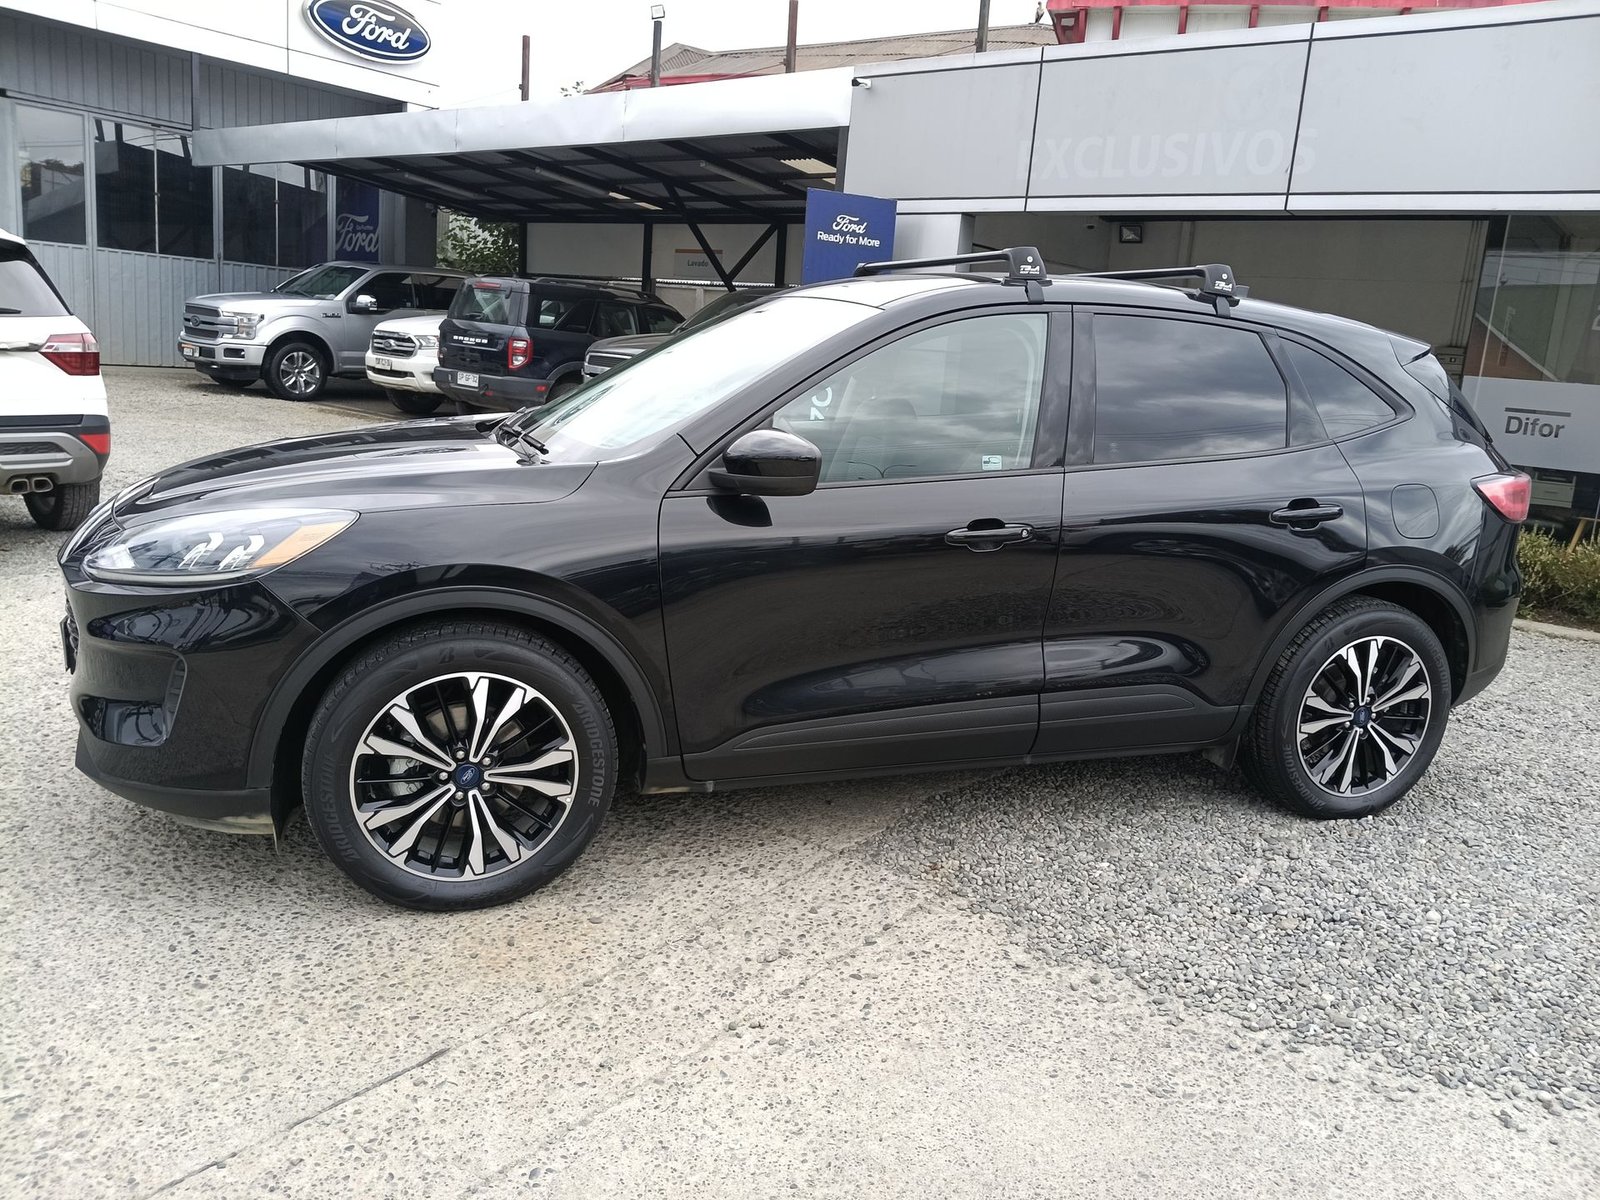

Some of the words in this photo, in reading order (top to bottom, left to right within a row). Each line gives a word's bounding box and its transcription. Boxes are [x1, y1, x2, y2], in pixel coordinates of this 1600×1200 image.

[342, 4, 411, 50] Ford
[1016, 127, 1319, 180] EXCLUSIVOS
[336, 213, 379, 253] Ford
[817, 231, 845, 244] Ready
[846, 235, 858, 245] for
[858, 236, 880, 247] More
[832, 214, 867, 234] Ford
[453, 335, 488, 344] BRONCO
[1504, 415, 1565, 439] Difor
[572, 699, 607, 807] BRIDGESTONE
